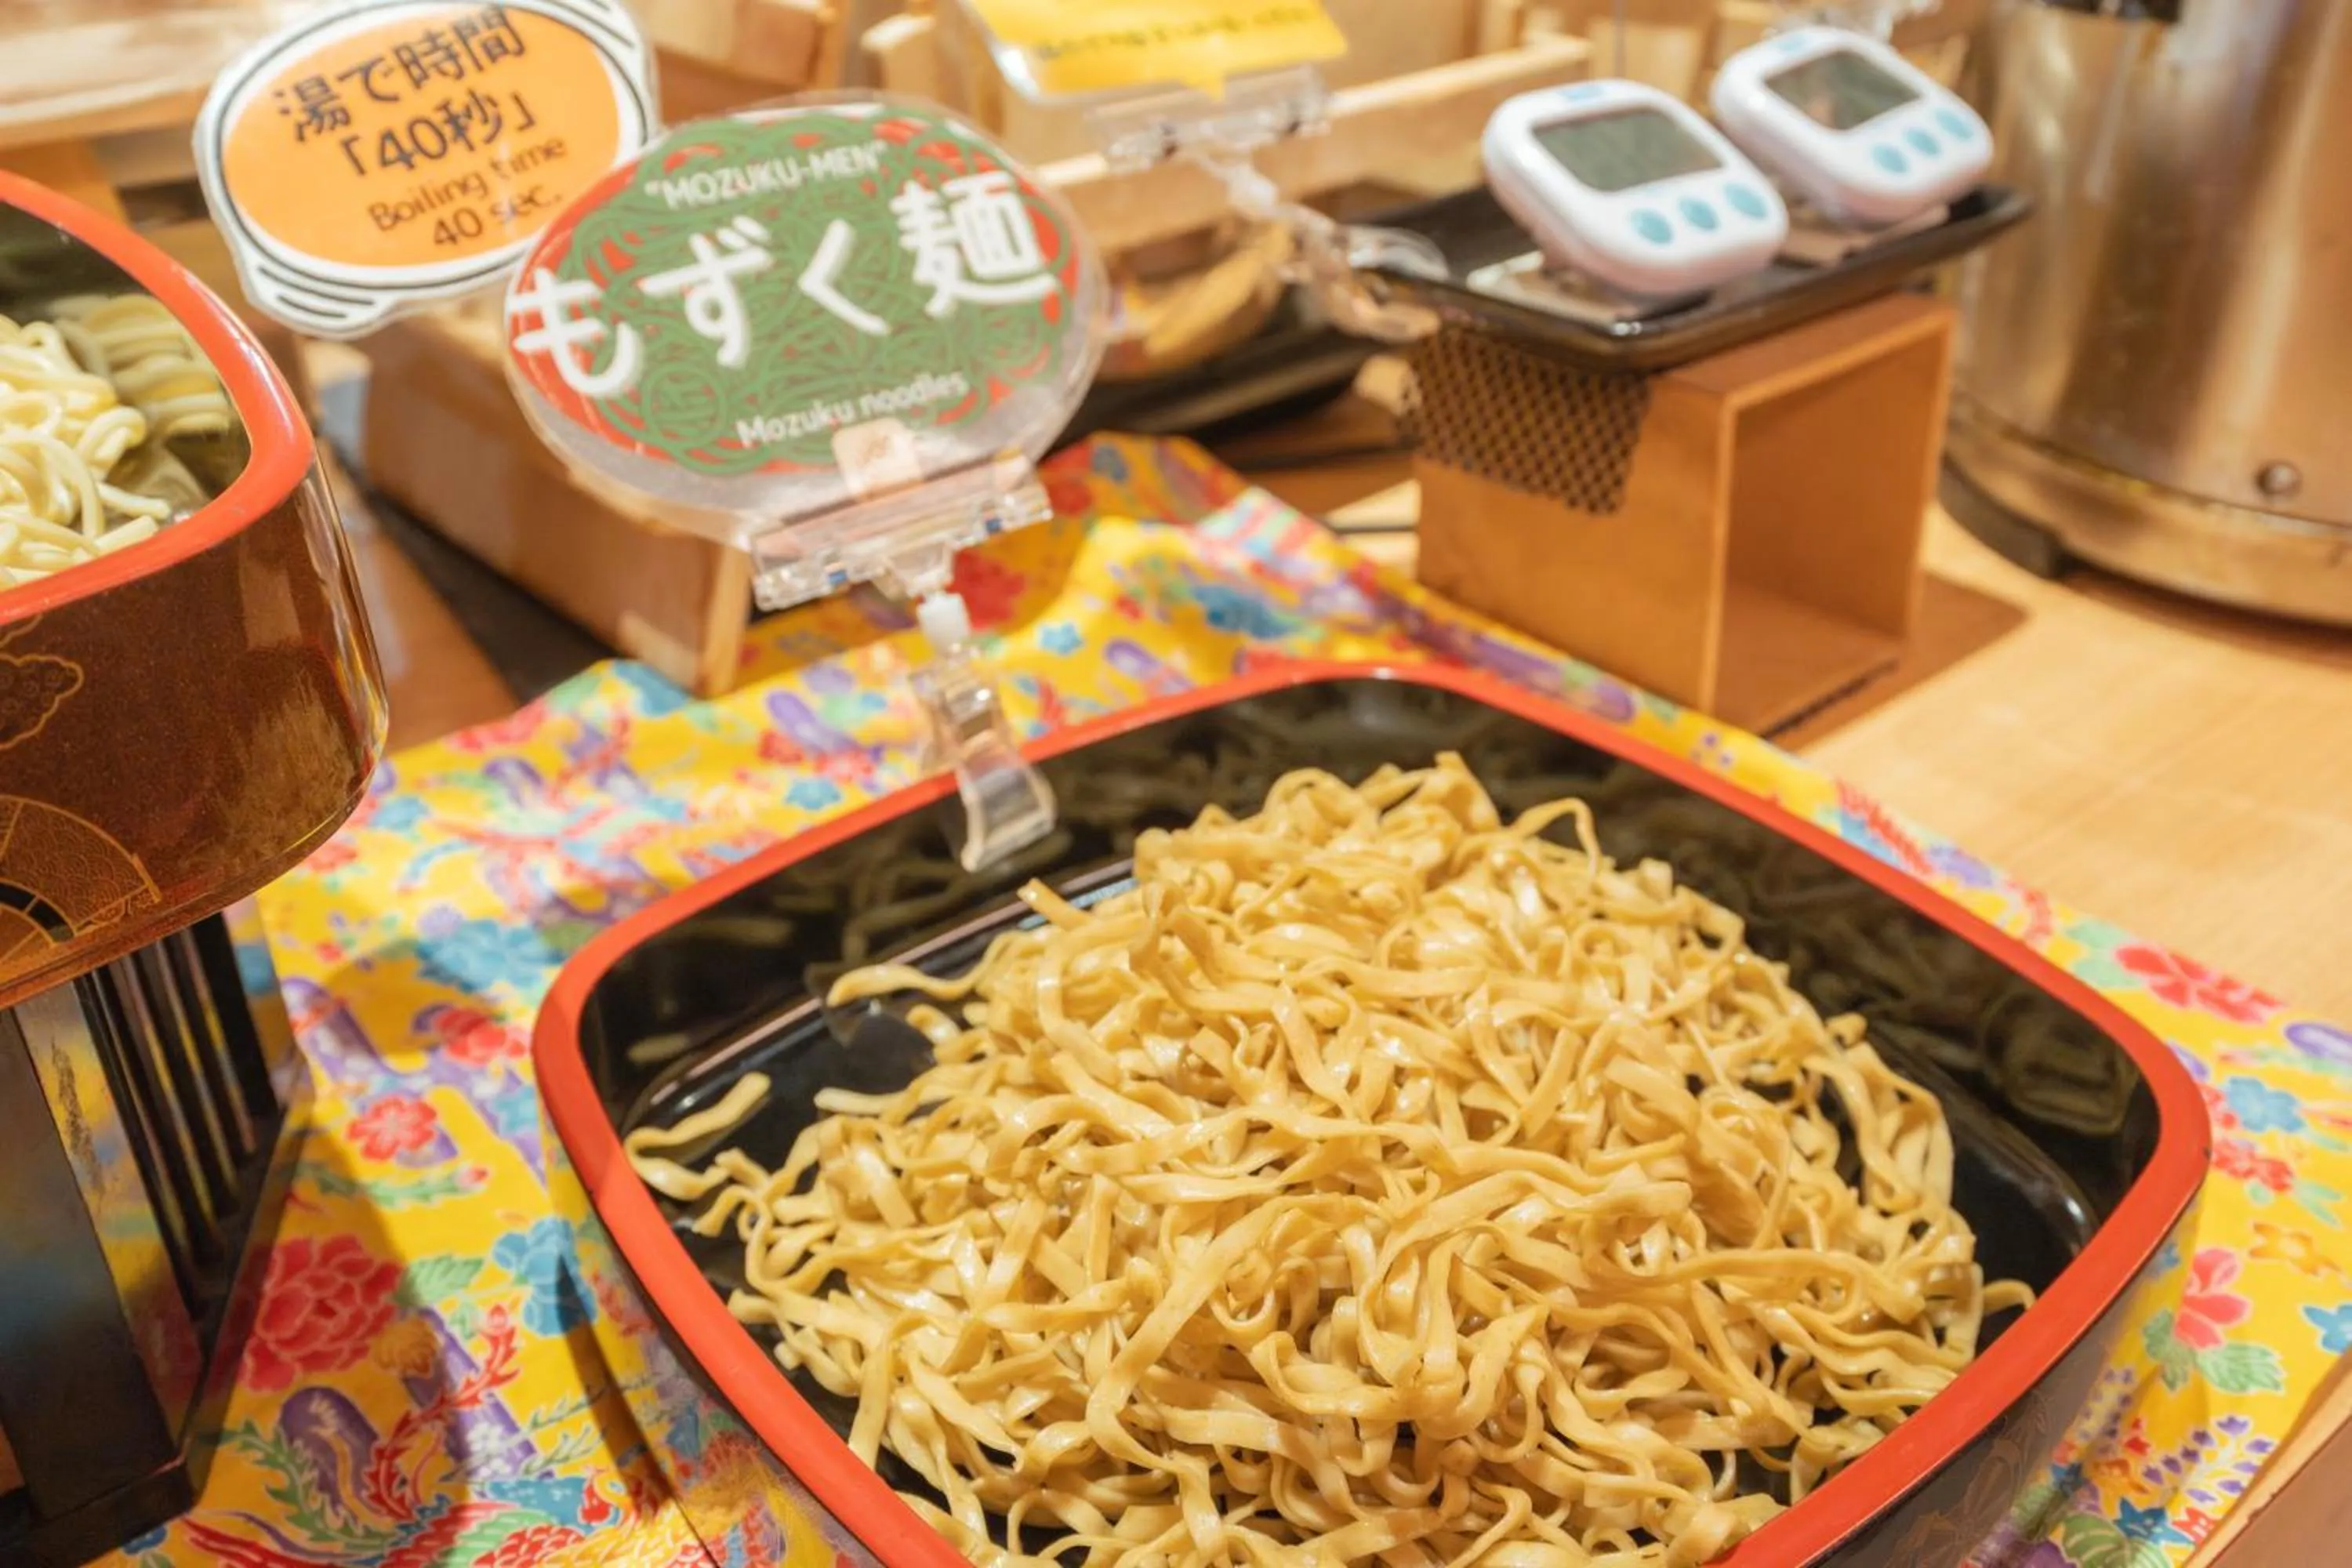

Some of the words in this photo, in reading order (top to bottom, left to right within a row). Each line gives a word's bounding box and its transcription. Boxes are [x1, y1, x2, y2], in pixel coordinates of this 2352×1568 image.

[274, 4, 525, 143] 湯で時間
[340, 89, 535, 176] 「40秒」
[368, 172, 489, 231] Boiling
[489, 138, 566, 179] time
[434, 207, 483, 245] 40
[489, 184, 562, 224] sec.
[504, 169, 1058, 397] もずく麺
[736, 399, 855, 448] Mozuku
[859, 372, 970, 417] noodles
